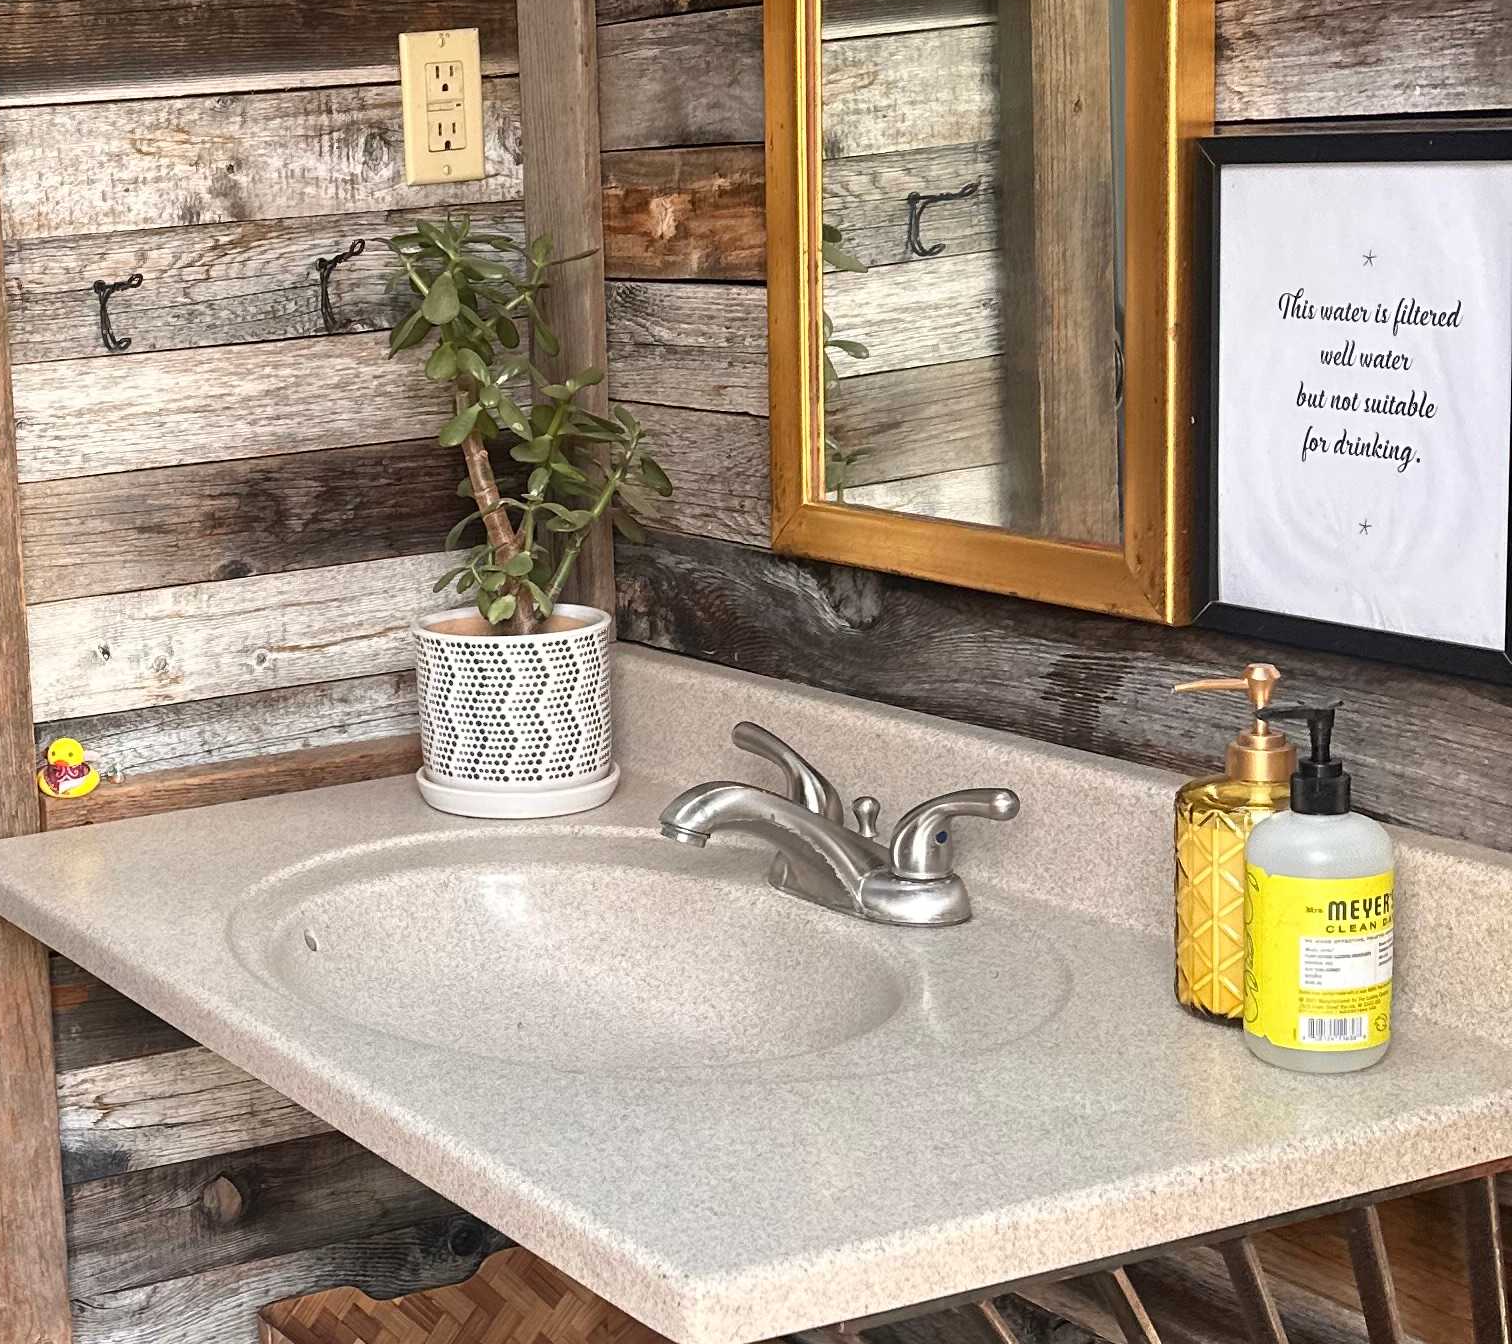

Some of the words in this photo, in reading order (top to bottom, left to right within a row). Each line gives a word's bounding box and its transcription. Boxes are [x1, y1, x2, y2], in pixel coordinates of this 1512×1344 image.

[1278, 287, 1316, 320] This
[1320, 302, 1370, 323] water
[1374, 303, 1391, 324] is
[1392, 297, 1463, 336] filtered
[1320, 339, 1356, 367] well
[1359, 350, 1413, 371] water
[1296, 380, 1326, 409] but
[1330, 392, 1360, 413] not
[1363, 389, 1438, 419] suitable
[1301, 425, 1330, 462] for
[1333, 428, 1421, 473] drinking.
[1326, 920, 1377, 933] CLEAN
